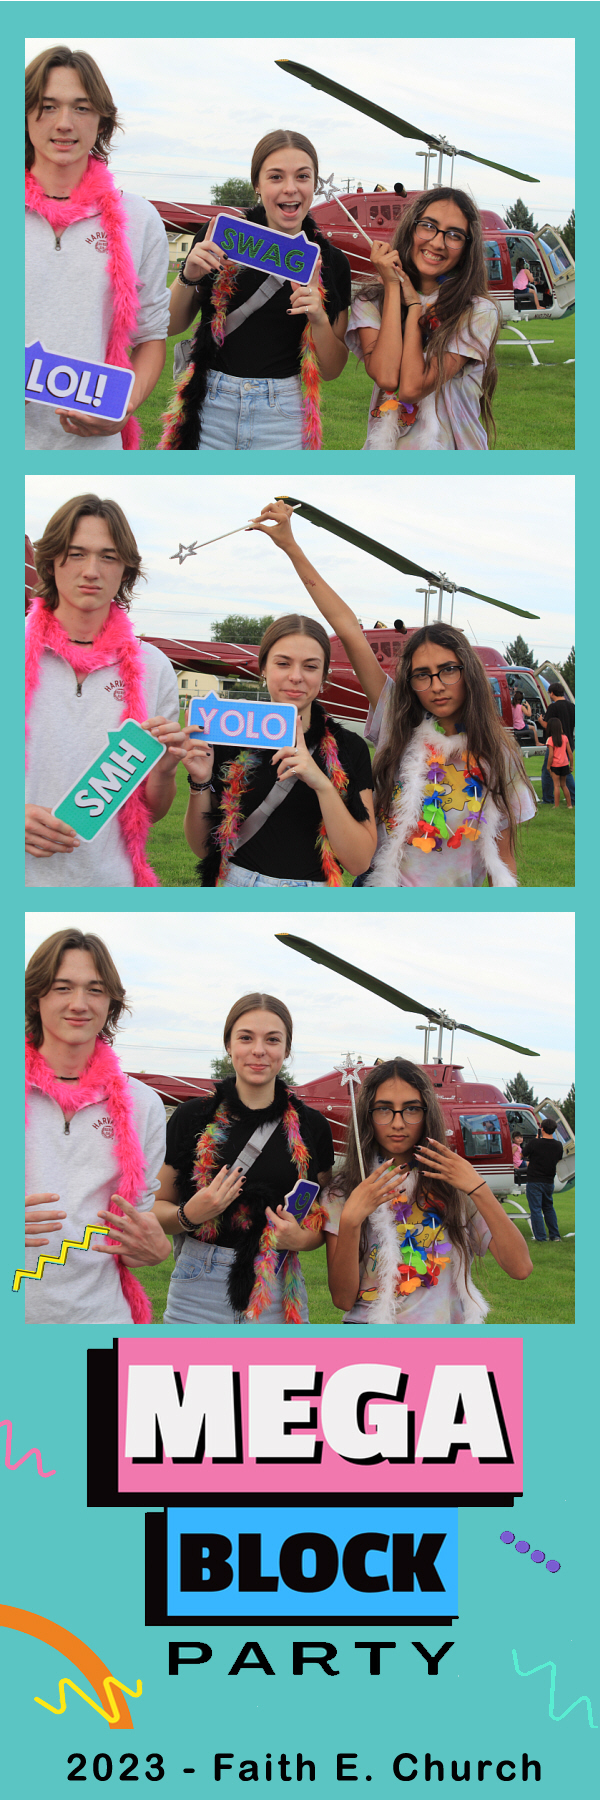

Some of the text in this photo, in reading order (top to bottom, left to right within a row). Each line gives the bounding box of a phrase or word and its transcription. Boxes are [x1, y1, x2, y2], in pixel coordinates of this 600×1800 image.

[220, 227, 305, 273] SWAG
[25, 358, 108, 408] LOL!
[197, 706, 288, 741] YOLO
[74, 738, 147, 818] SMH
